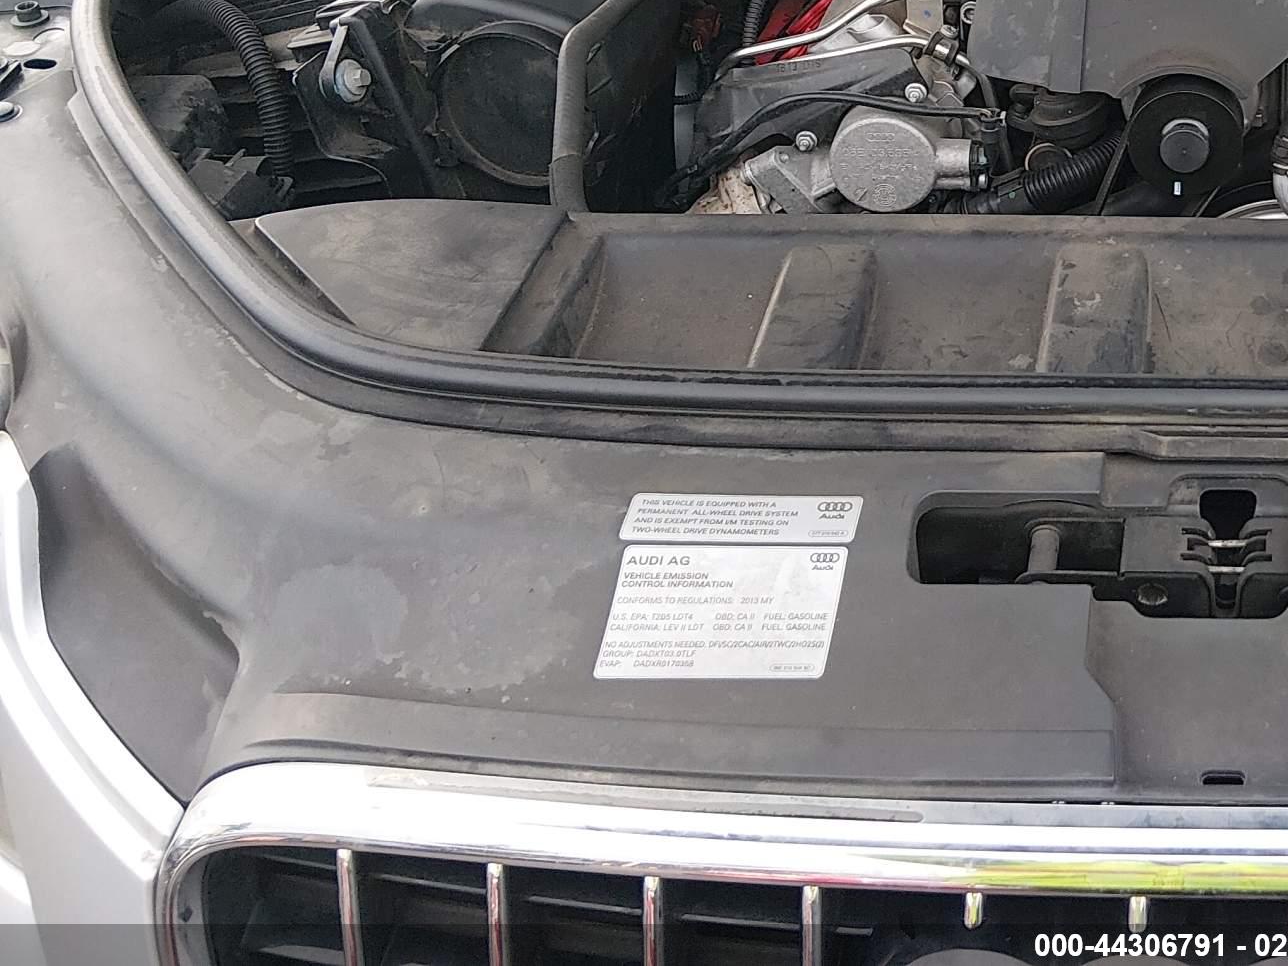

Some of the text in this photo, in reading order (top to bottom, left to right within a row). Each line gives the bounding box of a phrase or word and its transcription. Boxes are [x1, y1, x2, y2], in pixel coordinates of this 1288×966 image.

[705, 500, 746, 508] EQUIPPED
[692, 509, 737, 517] ALL-WHEEL
[631, 526, 681, 534] TWO-WHEEL
[709, 528, 780, 536] DYNAMOMETERS
[626, 555, 691, 566] AUDI AG
[624, 572, 709, 580] VEHICLE EMISSION
[621, 580, 734, 588] CONTROL INFORMATION
[617, 596, 663, 604] CONFORMS
[737, 613, 748, 621] CA
[787, 613, 828, 621] GASOLINE
[663, 623, 680, 631] LEV
[734, 623, 745, 631] CA
[785, 623, 826, 631] GASOLINE
[605, 640, 618, 648] NO
[618, 640, 673, 648] ADJUSTMENTS
